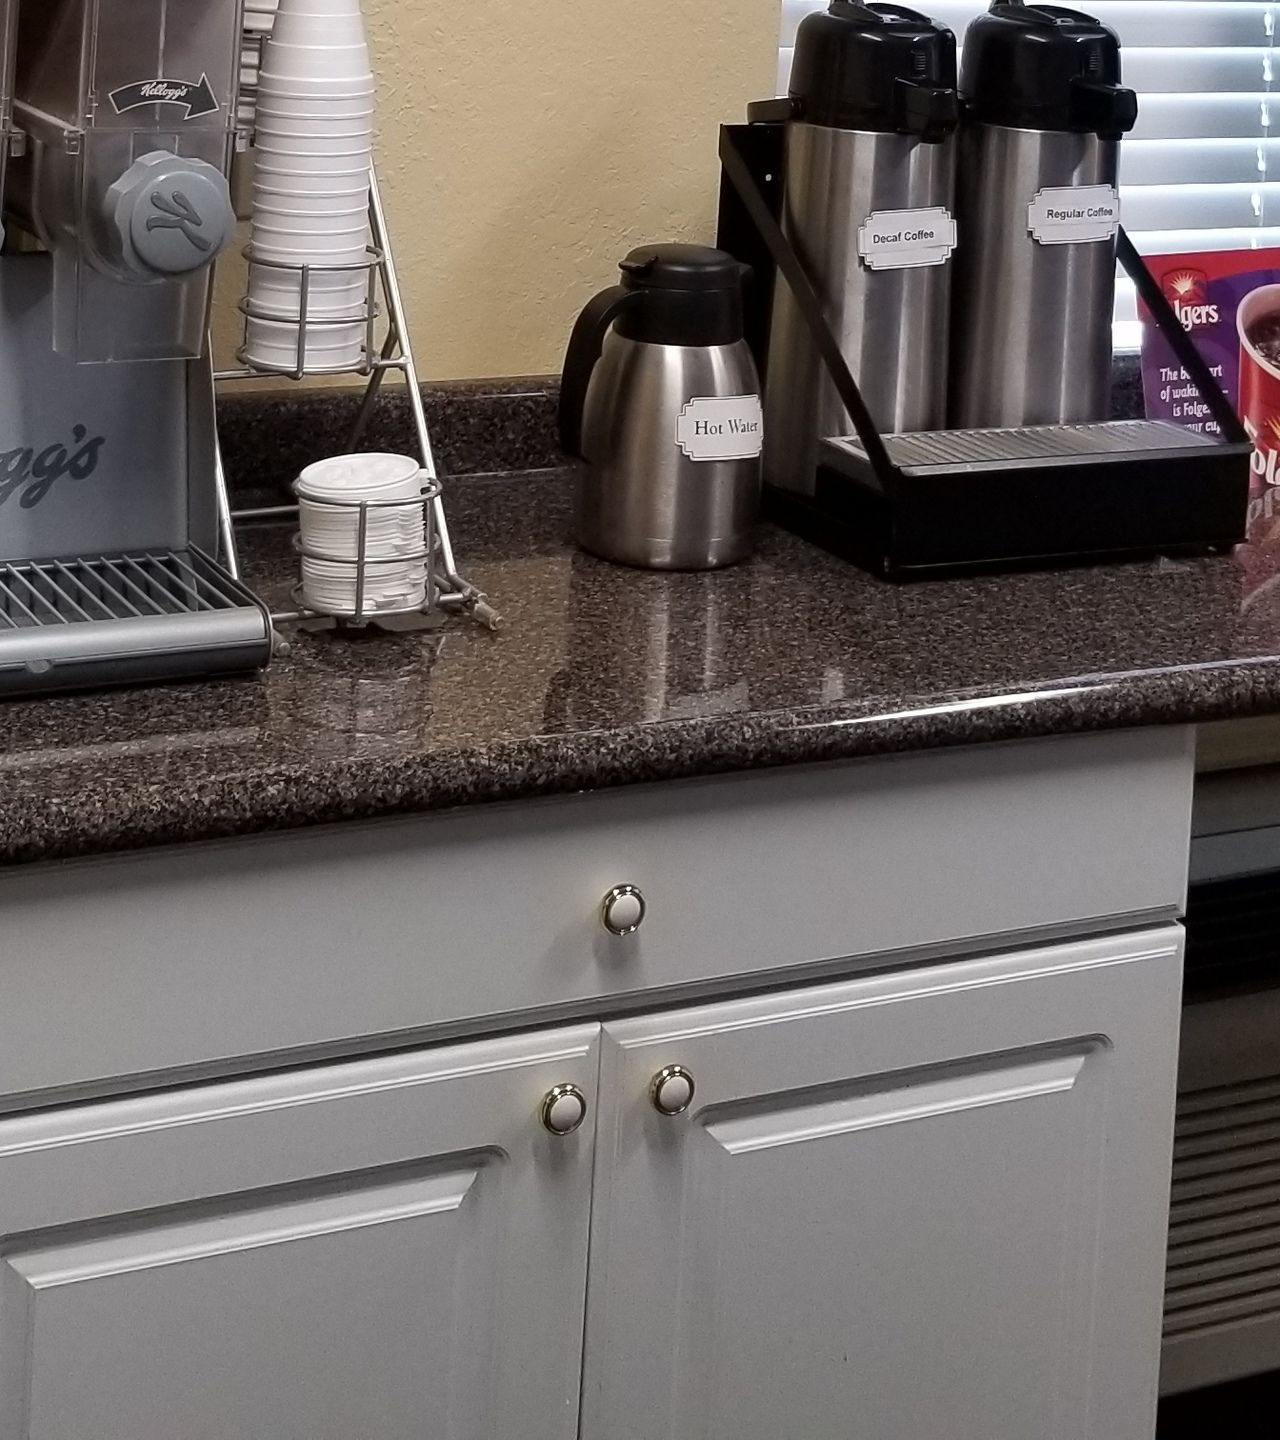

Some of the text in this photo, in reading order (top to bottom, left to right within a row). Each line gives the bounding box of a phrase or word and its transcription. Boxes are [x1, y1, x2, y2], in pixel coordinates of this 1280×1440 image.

[140, 82, 189, 100] Kellogg's
[1046, 206, 1114, 221] Regular Coffee
[873, 230, 934, 244] Decaf Coffee
[1160, 367, 1179, 382] The
[1160, 385, 1171, 403] of
[1173, 403, 1182, 417] is
[694, 418, 758, 435] Hot Water
